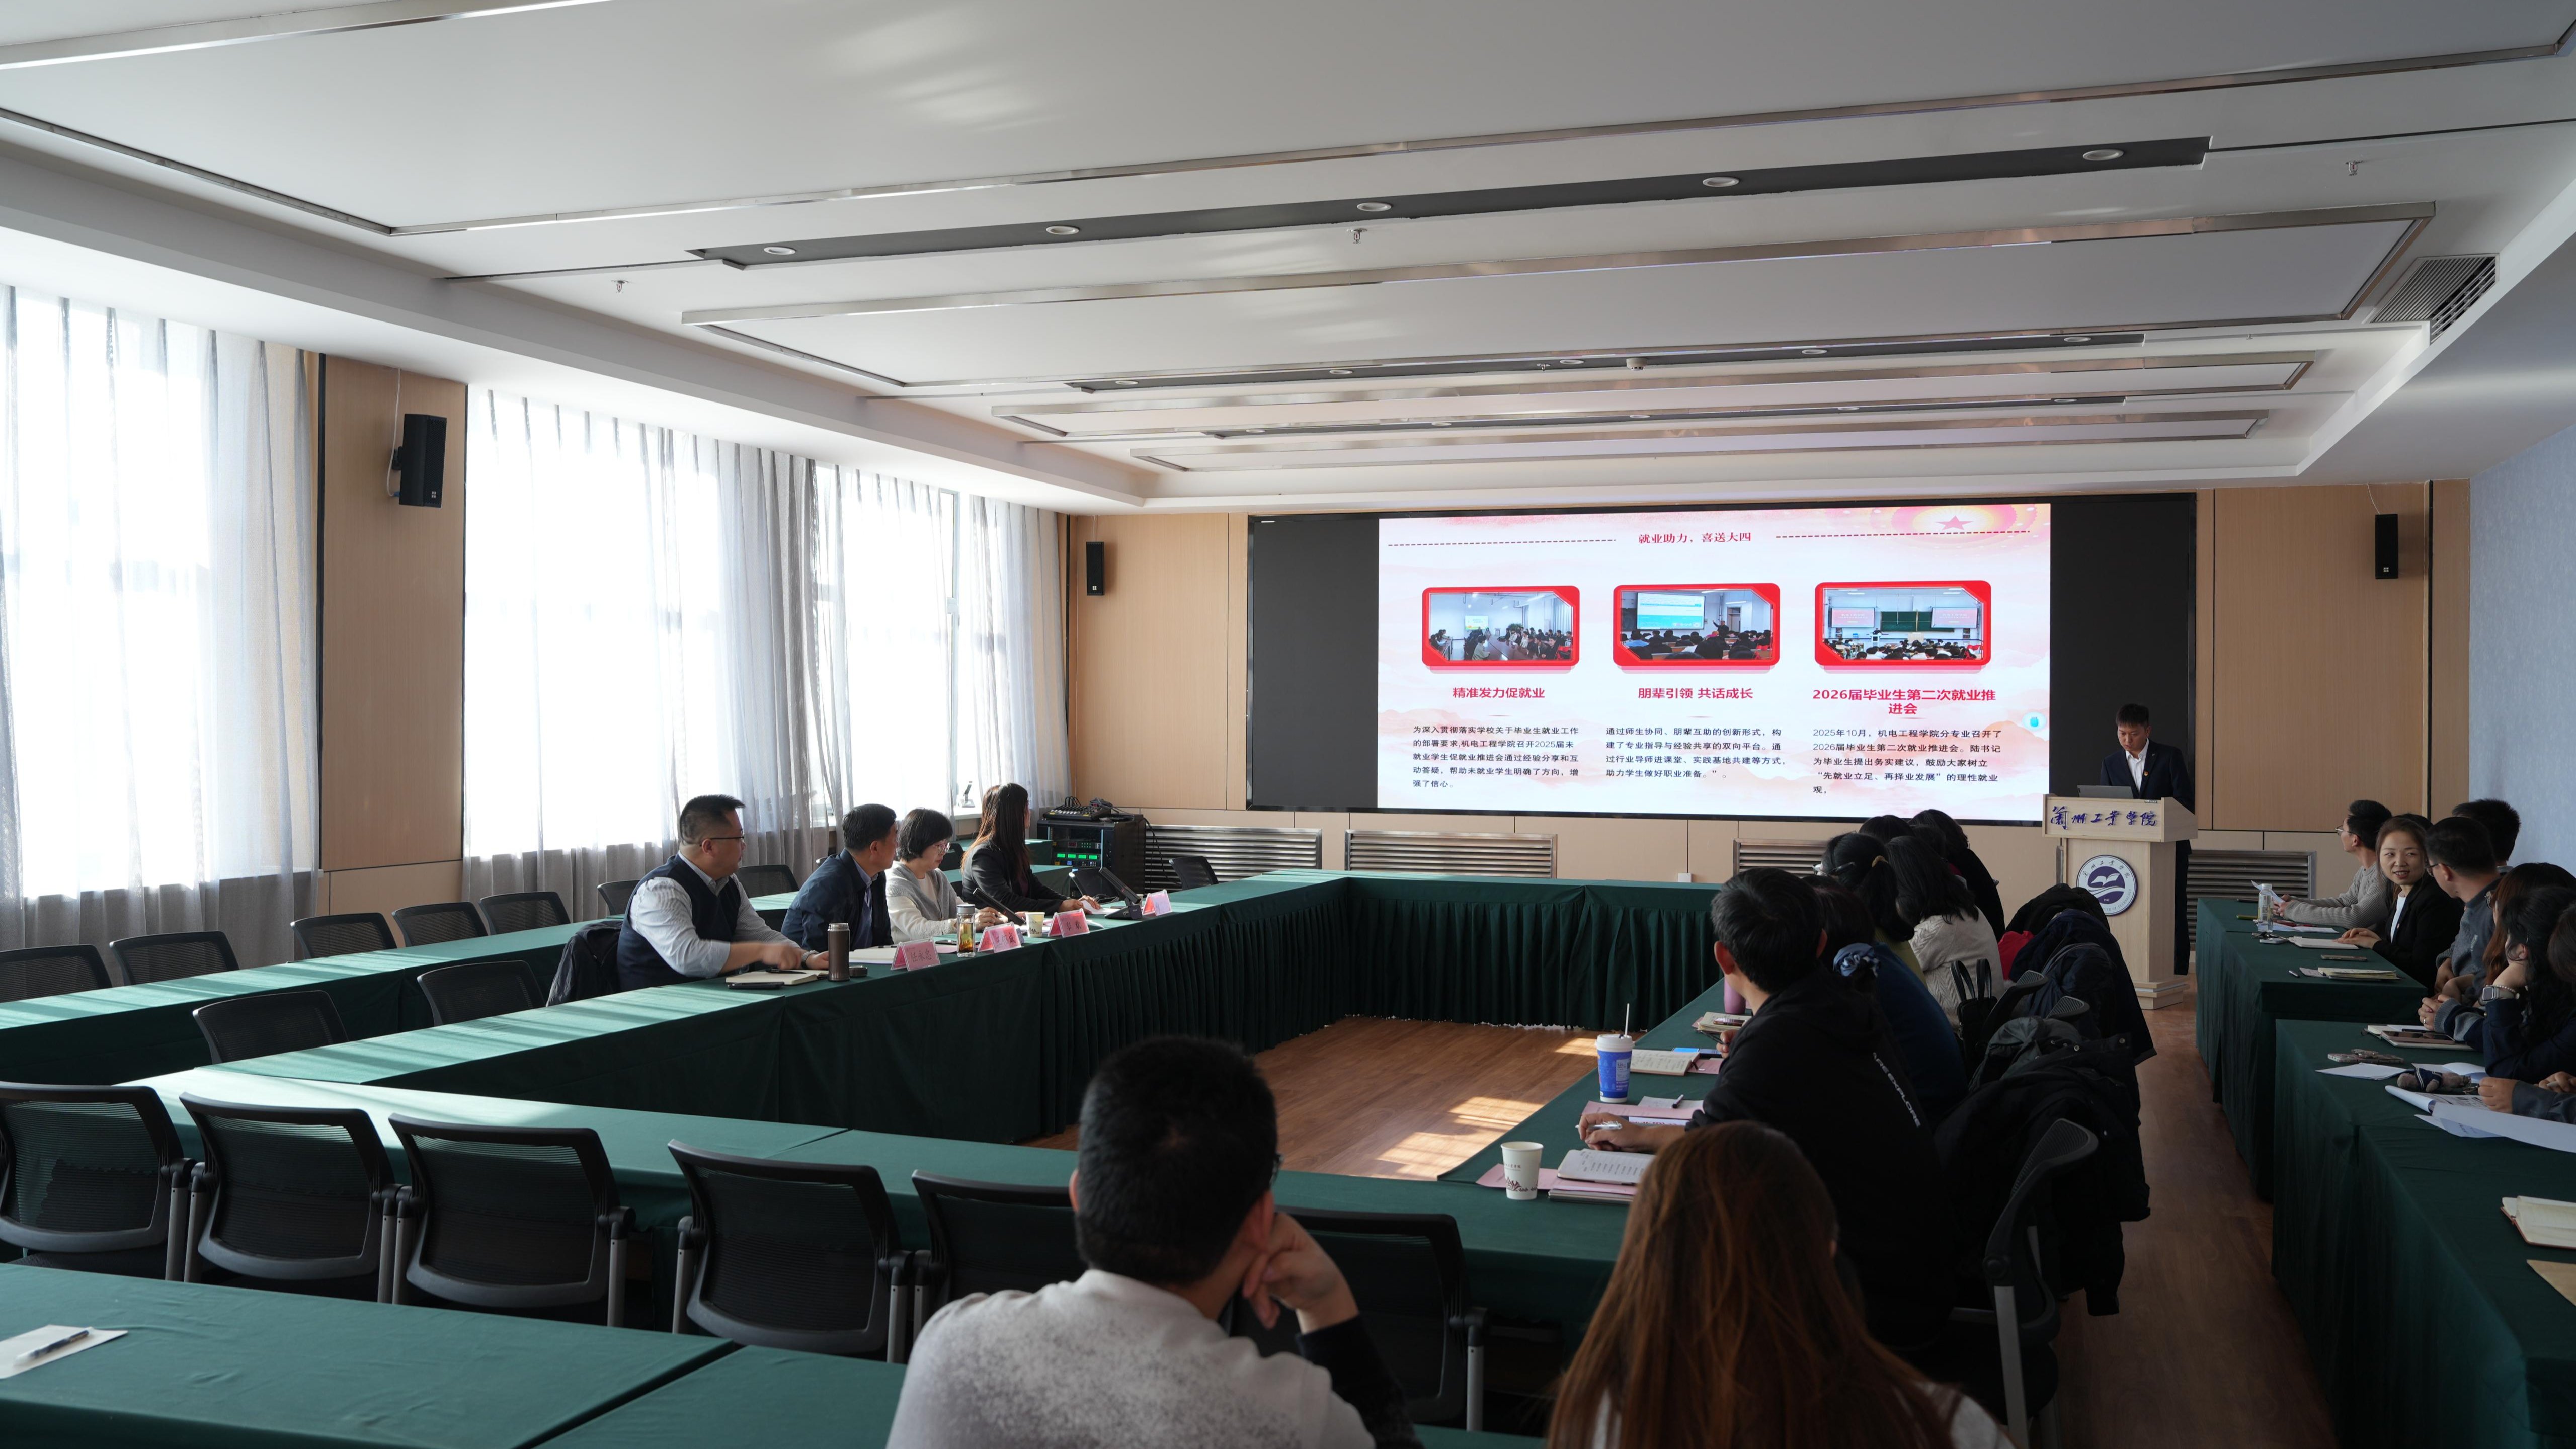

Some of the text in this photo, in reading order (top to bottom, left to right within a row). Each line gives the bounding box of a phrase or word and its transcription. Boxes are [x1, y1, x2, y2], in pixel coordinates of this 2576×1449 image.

[1638, 532, 1751, 544] 就业助力，喜送大四
[1453, 687, 1545, 698] 精准发力促就业
[1638, 687, 1753, 699] 朋辈引领 共话成长
[1812, 689, 1996, 701] 2026届毕业生第二次就业推
[1888, 703, 1918, 714] 进会
[1413, 726, 1579, 735] 为深入贯彻落实学校关于毕业生就业工作
[1606, 727, 1781, 737] 通过师生协同、朋辈互助的创新形式，构
[1813, 728, 2002, 738] 2025年10月，机电工程学院分专业召开了
[1606, 741, 1781, 751] 建了专业指导与经验共享的双向平台。通
[1813, 743, 2001, 753] 2026届毕业生第二次就业推进会。陆书记
[1413, 753, 1579, 762] 就业学生促就业推进会通过经验分享和互
[1606, 755, 1786, 765] 过行业导师进课堂、实践基地共建等方式，
[1813, 757, 1988, 767] 为毕业生提出务实建议，鼓励大家树立
[1413, 766, 1579, 776] 动答疑，帮助未就业学生明确了方向，增
[1413, 780, 1454, 788] 强了信心。
[1888, 1073, 1921, 1128] EXPLORE
